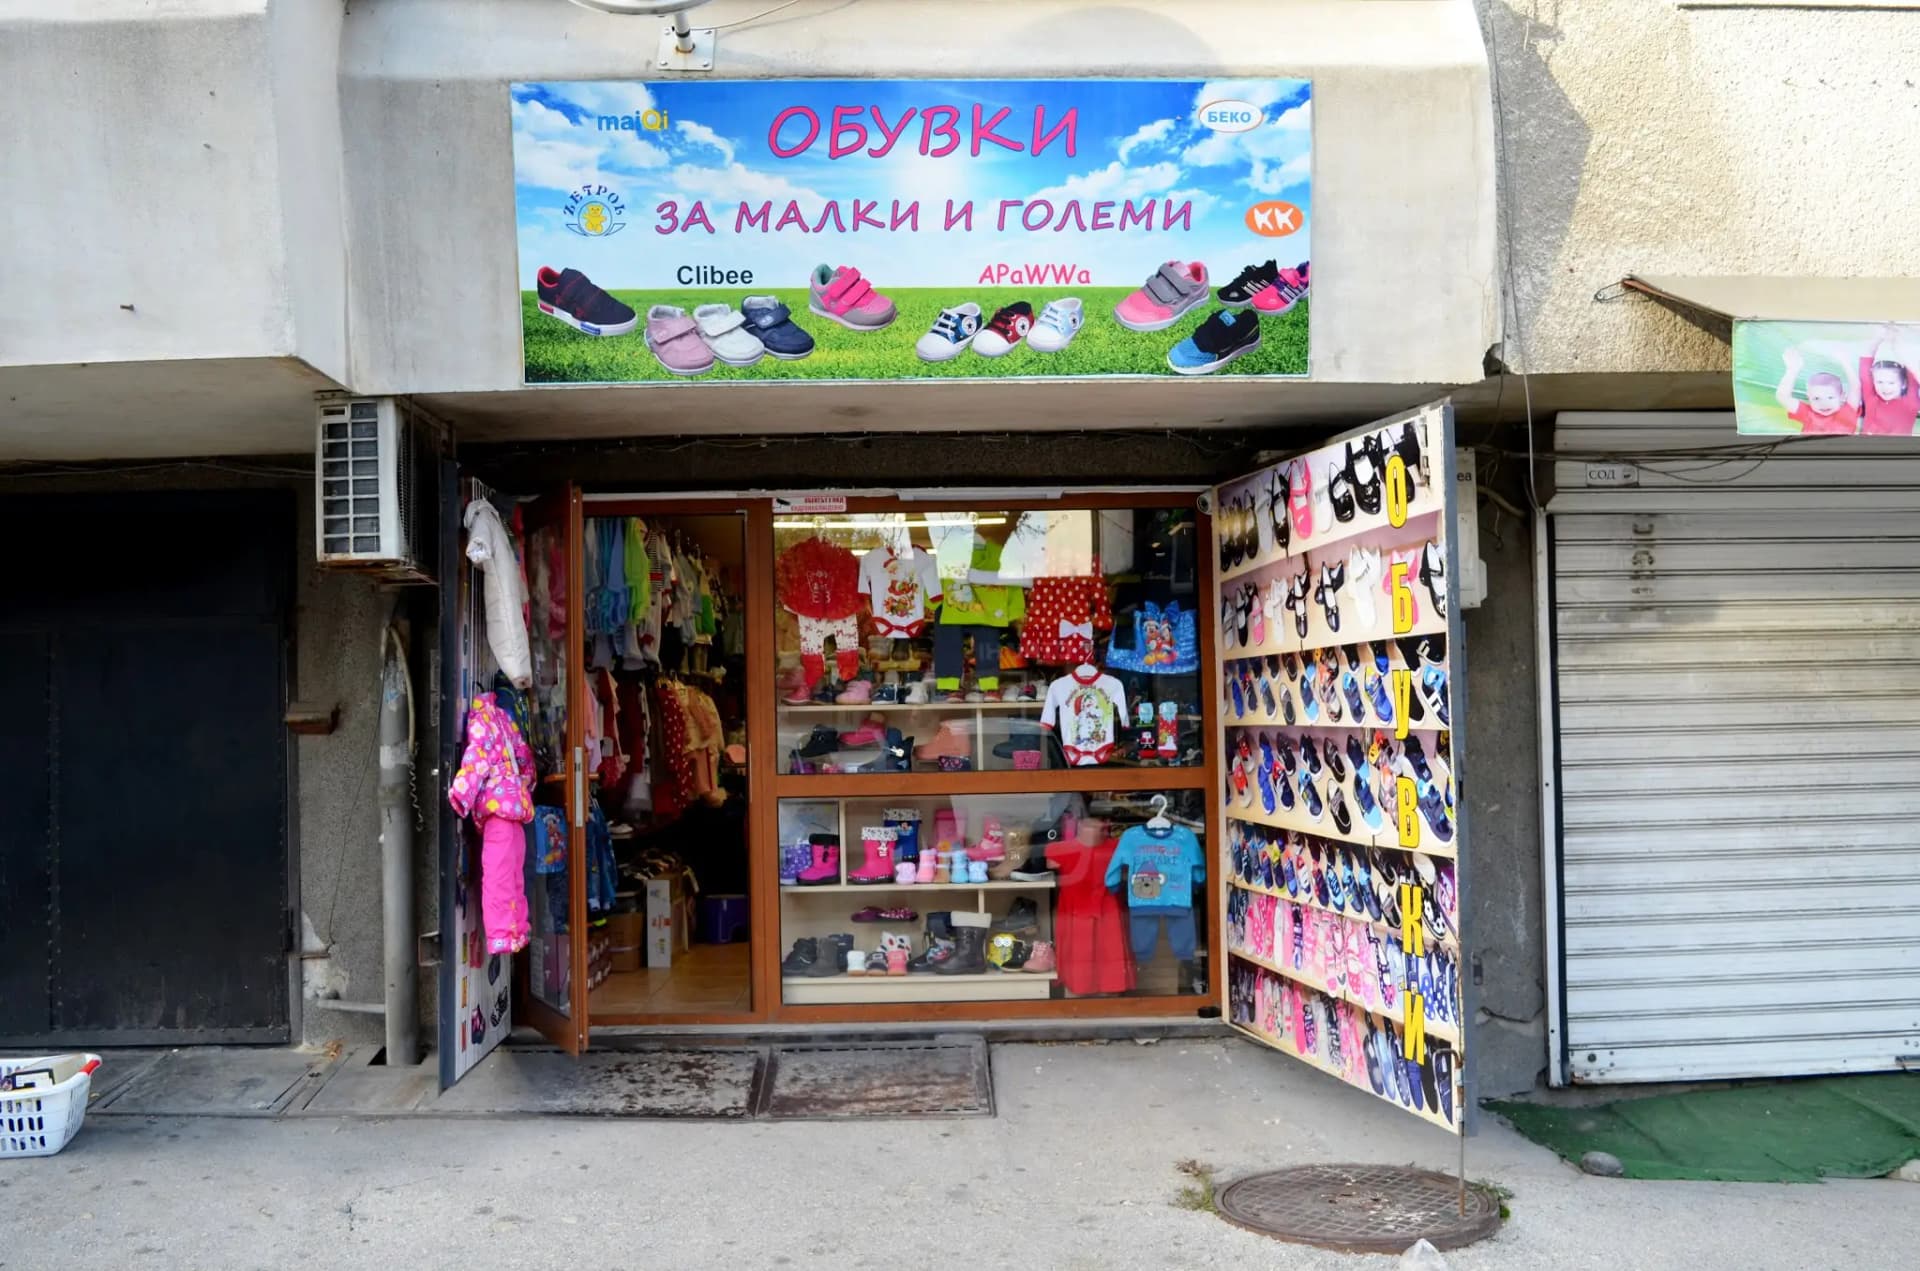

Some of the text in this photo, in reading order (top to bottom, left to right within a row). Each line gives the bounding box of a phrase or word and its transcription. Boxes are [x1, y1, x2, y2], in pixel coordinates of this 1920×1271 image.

[597, 108, 669, 132] maiQi
[1206, 110, 1252, 124] БЕКО
[767, 103, 1079, 160] ОБУВКИ
[654, 199, 1192, 234] ЗА МАЛКИ И ГОЛЕМИ
[676, 264, 754, 286] Clibee
[978, 263, 1091, 285] APaWWa
